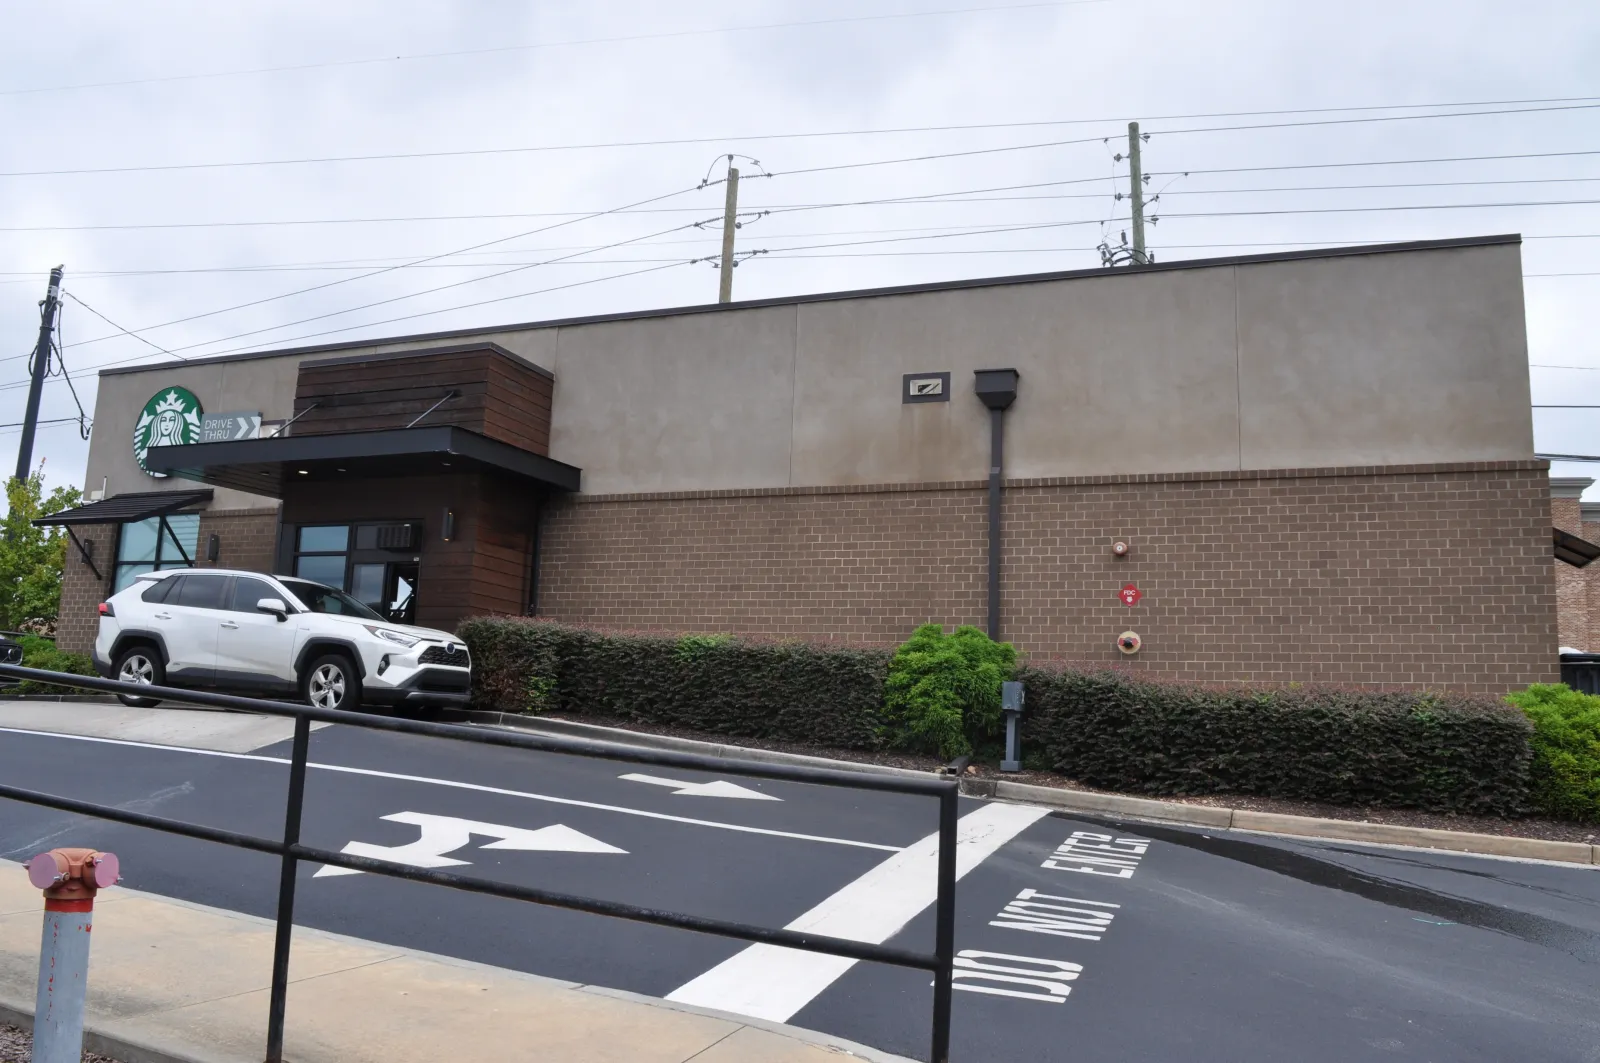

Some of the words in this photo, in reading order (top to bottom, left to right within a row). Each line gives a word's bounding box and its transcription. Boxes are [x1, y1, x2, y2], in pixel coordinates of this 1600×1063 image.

[204, 418, 233, 430] DRIVE
[204, 430, 230, 441] THRU
[1040, 831, 1151, 879] ENTER
[988, 888, 1121, 941] NOT
[930, 949, 1084, 1004] DO
